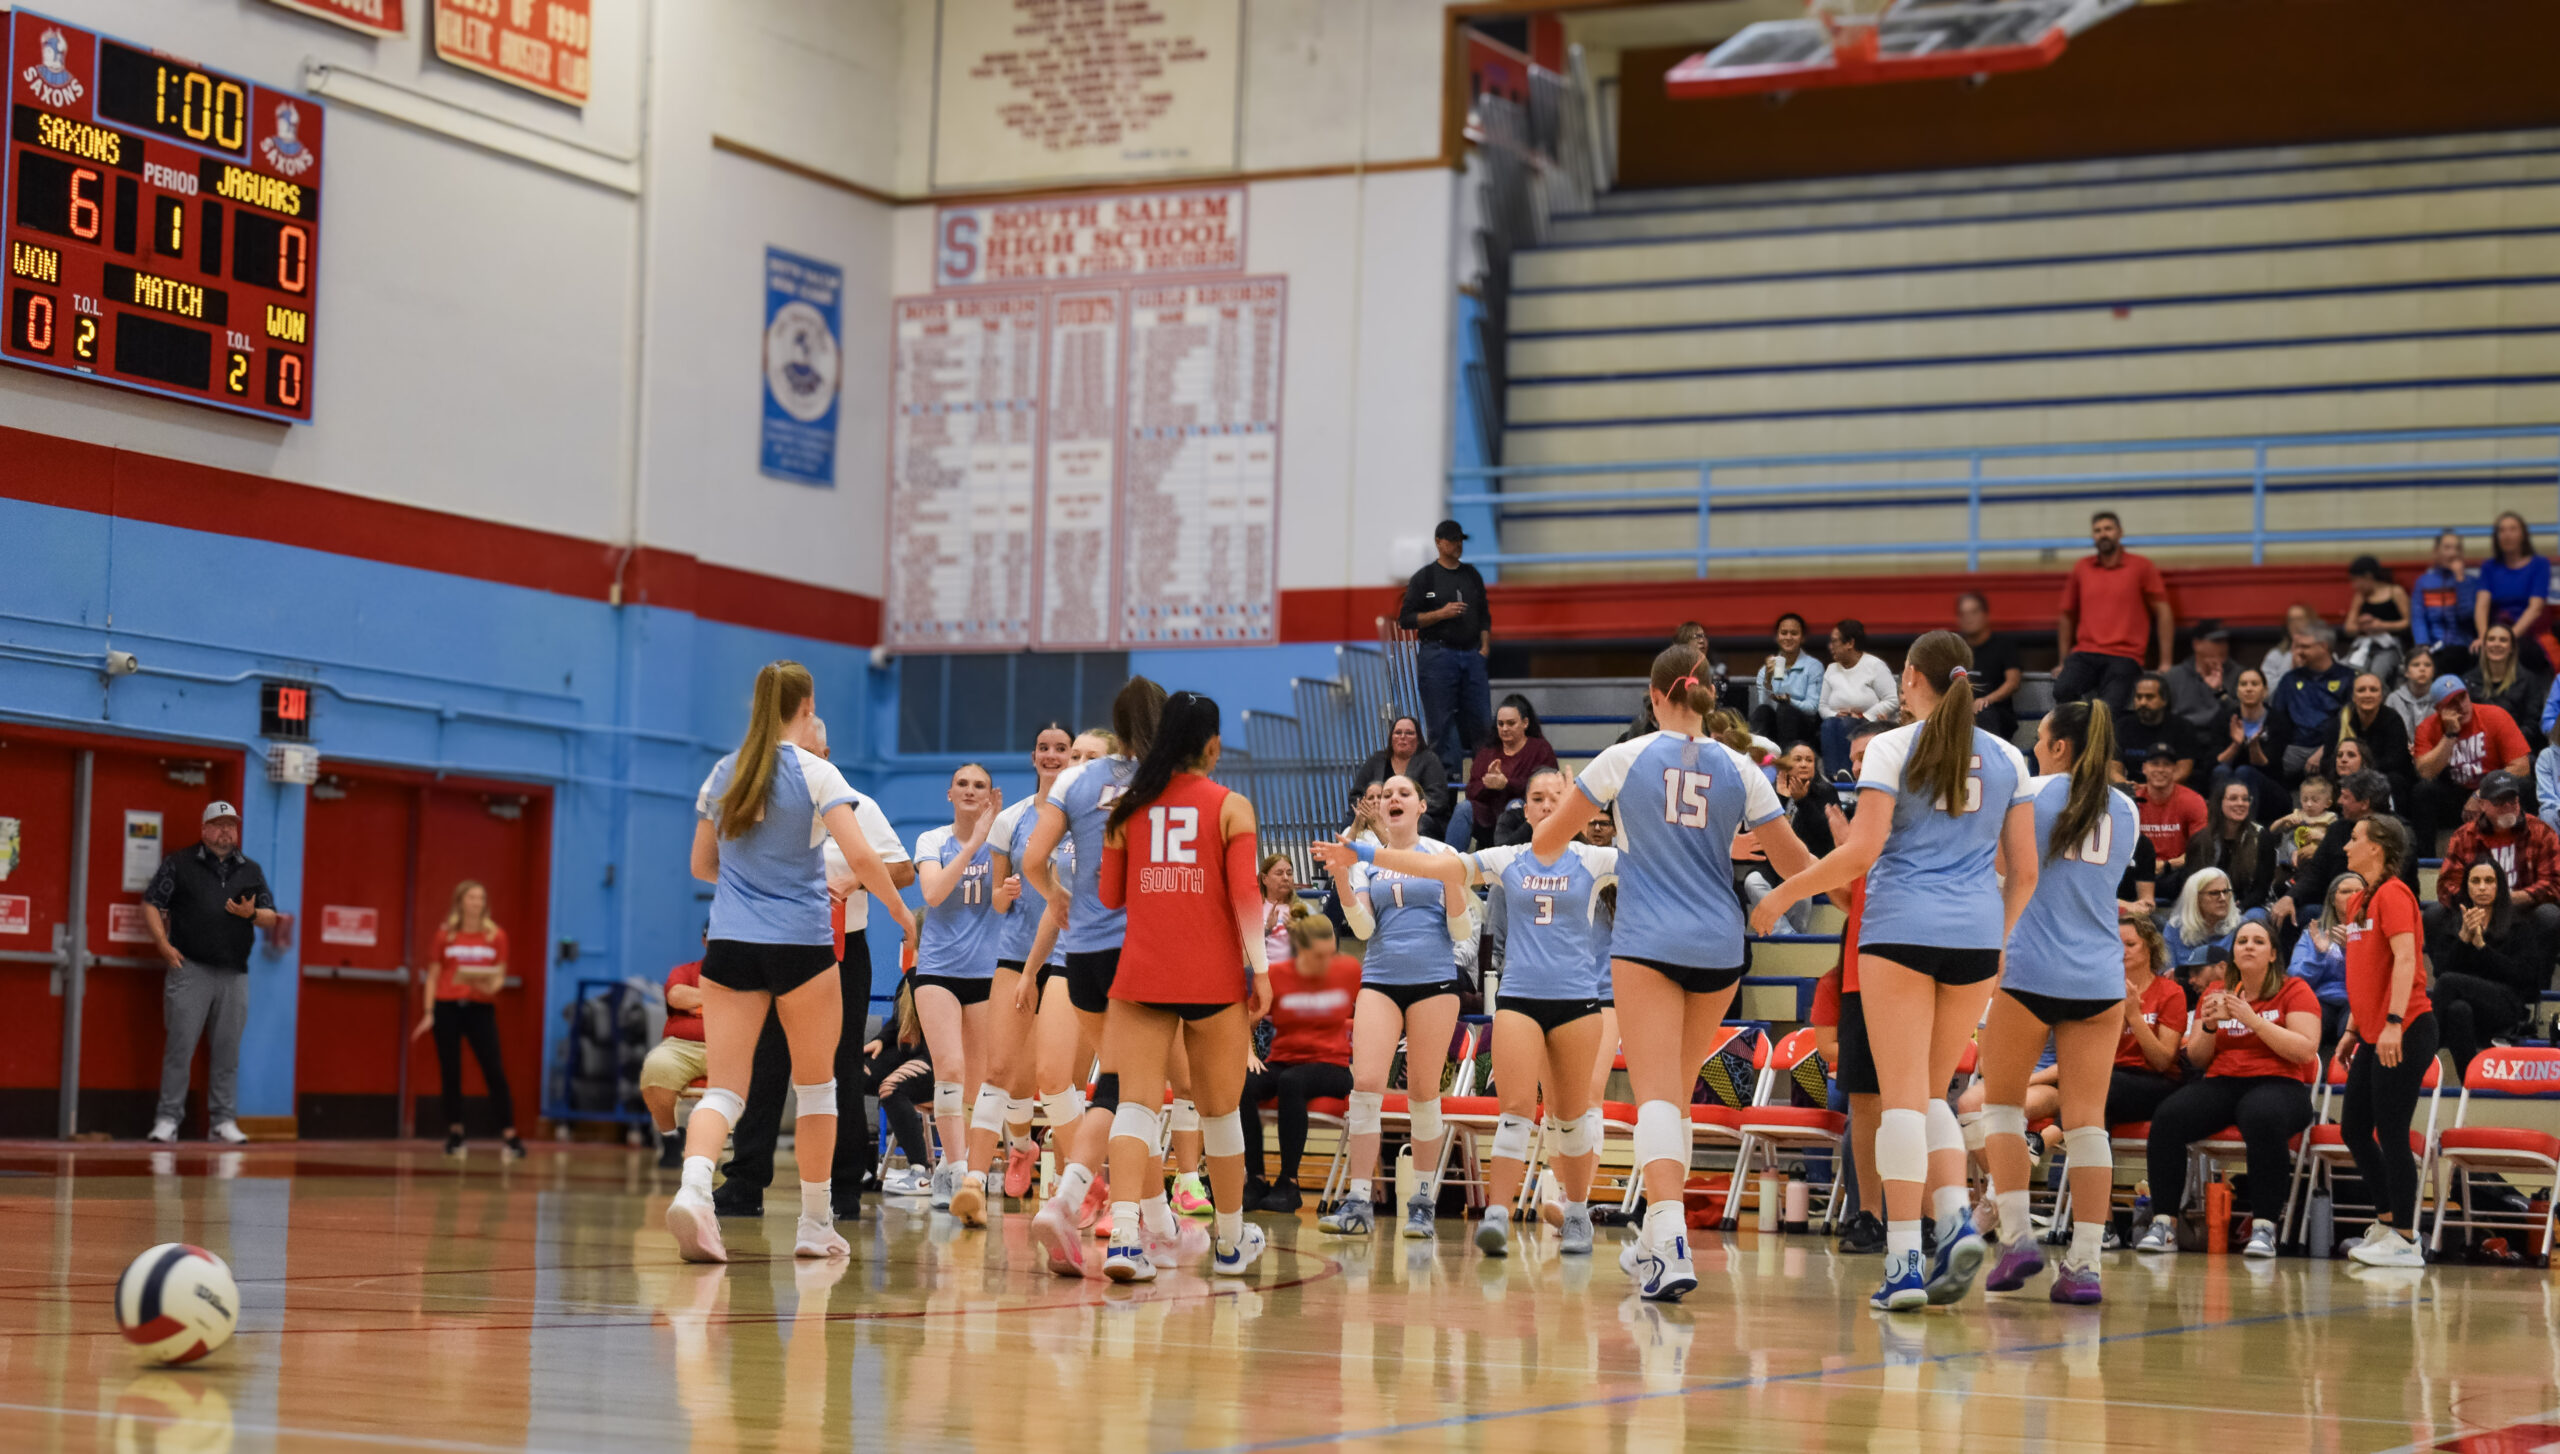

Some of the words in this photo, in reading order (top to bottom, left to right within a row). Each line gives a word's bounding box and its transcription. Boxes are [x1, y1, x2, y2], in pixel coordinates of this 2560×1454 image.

[23, 67, 84, 107] SAXONS
[156, 67, 244, 149] 1:00
[38, 114, 120, 165] SAXONS
[260, 137, 314, 176] SAXONS
[144, 162, 198, 196] PERIOD
[216, 166, 301, 215] JAGUARS
[70, 168, 99, 239] 6
[993, 205, 1098, 231] SOUTH
[1116, 197, 1228, 223] SALEM
[172, 206, 181, 250] 1
[945, 216, 978, 278] S
[986, 232, 1075, 257] HIGH
[1093, 223, 1231, 251] SCHOOL
[14, 242, 58, 283] WON
[279, 225, 307, 292] 0
[135, 273, 203, 318] MATCH
[28, 295, 52, 350] 0
[77, 319, 95, 357] 2
[266, 305, 306, 343] WON
[229, 354, 247, 391] 2
[279, 354, 301, 406] 0
[220, 804, 229, 813] P
[1663, 767, 1712, 829] 15
[1148, 806, 1199, 863] 12
[963, 879, 982, 905] 11
[1139, 866, 1204, 894] SOUTH
[1391, 881, 1405, 908] 1
[1521, 875, 1570, 892] SOUTH
[1534, 894, 1554, 925] 3
[2482, 1058, 2560, 1081] SAXONS
